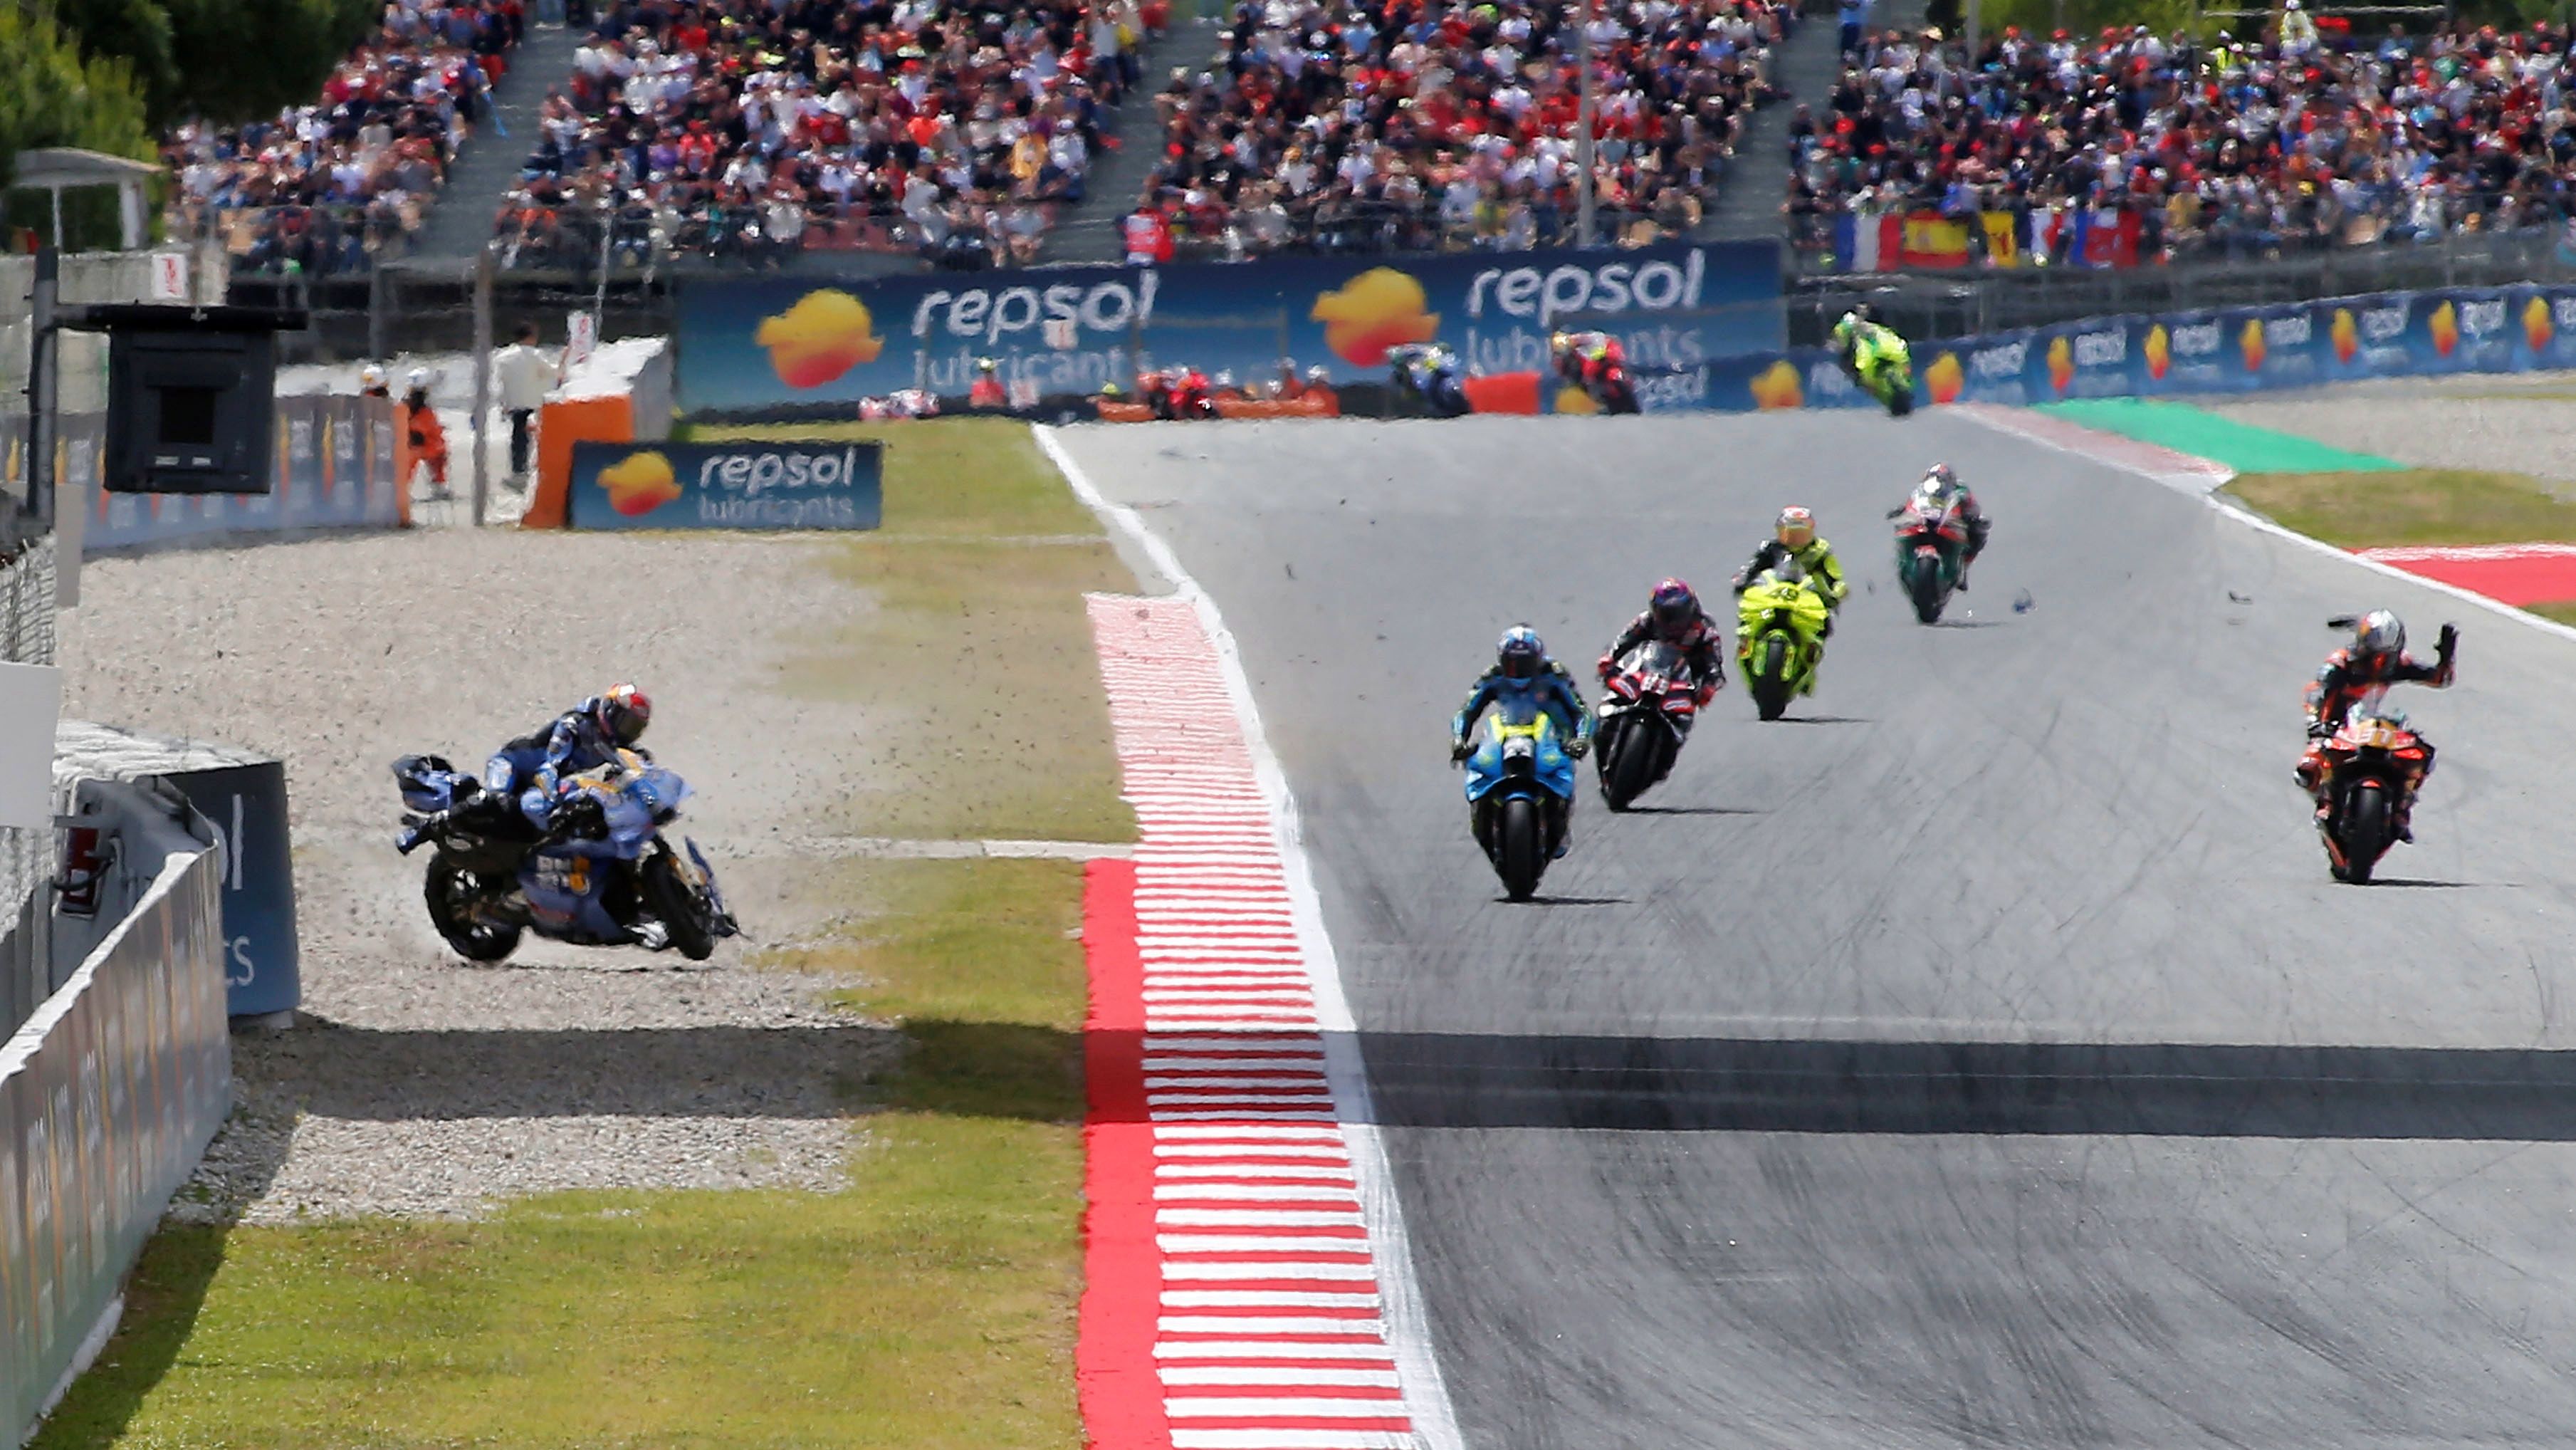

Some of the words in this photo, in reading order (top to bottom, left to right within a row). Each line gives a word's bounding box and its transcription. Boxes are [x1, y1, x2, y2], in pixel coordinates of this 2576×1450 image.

[911, 268, 1160, 347] repsol
[1465, 247, 1706, 328] repsol
[698, 447, 857, 497] repsol
